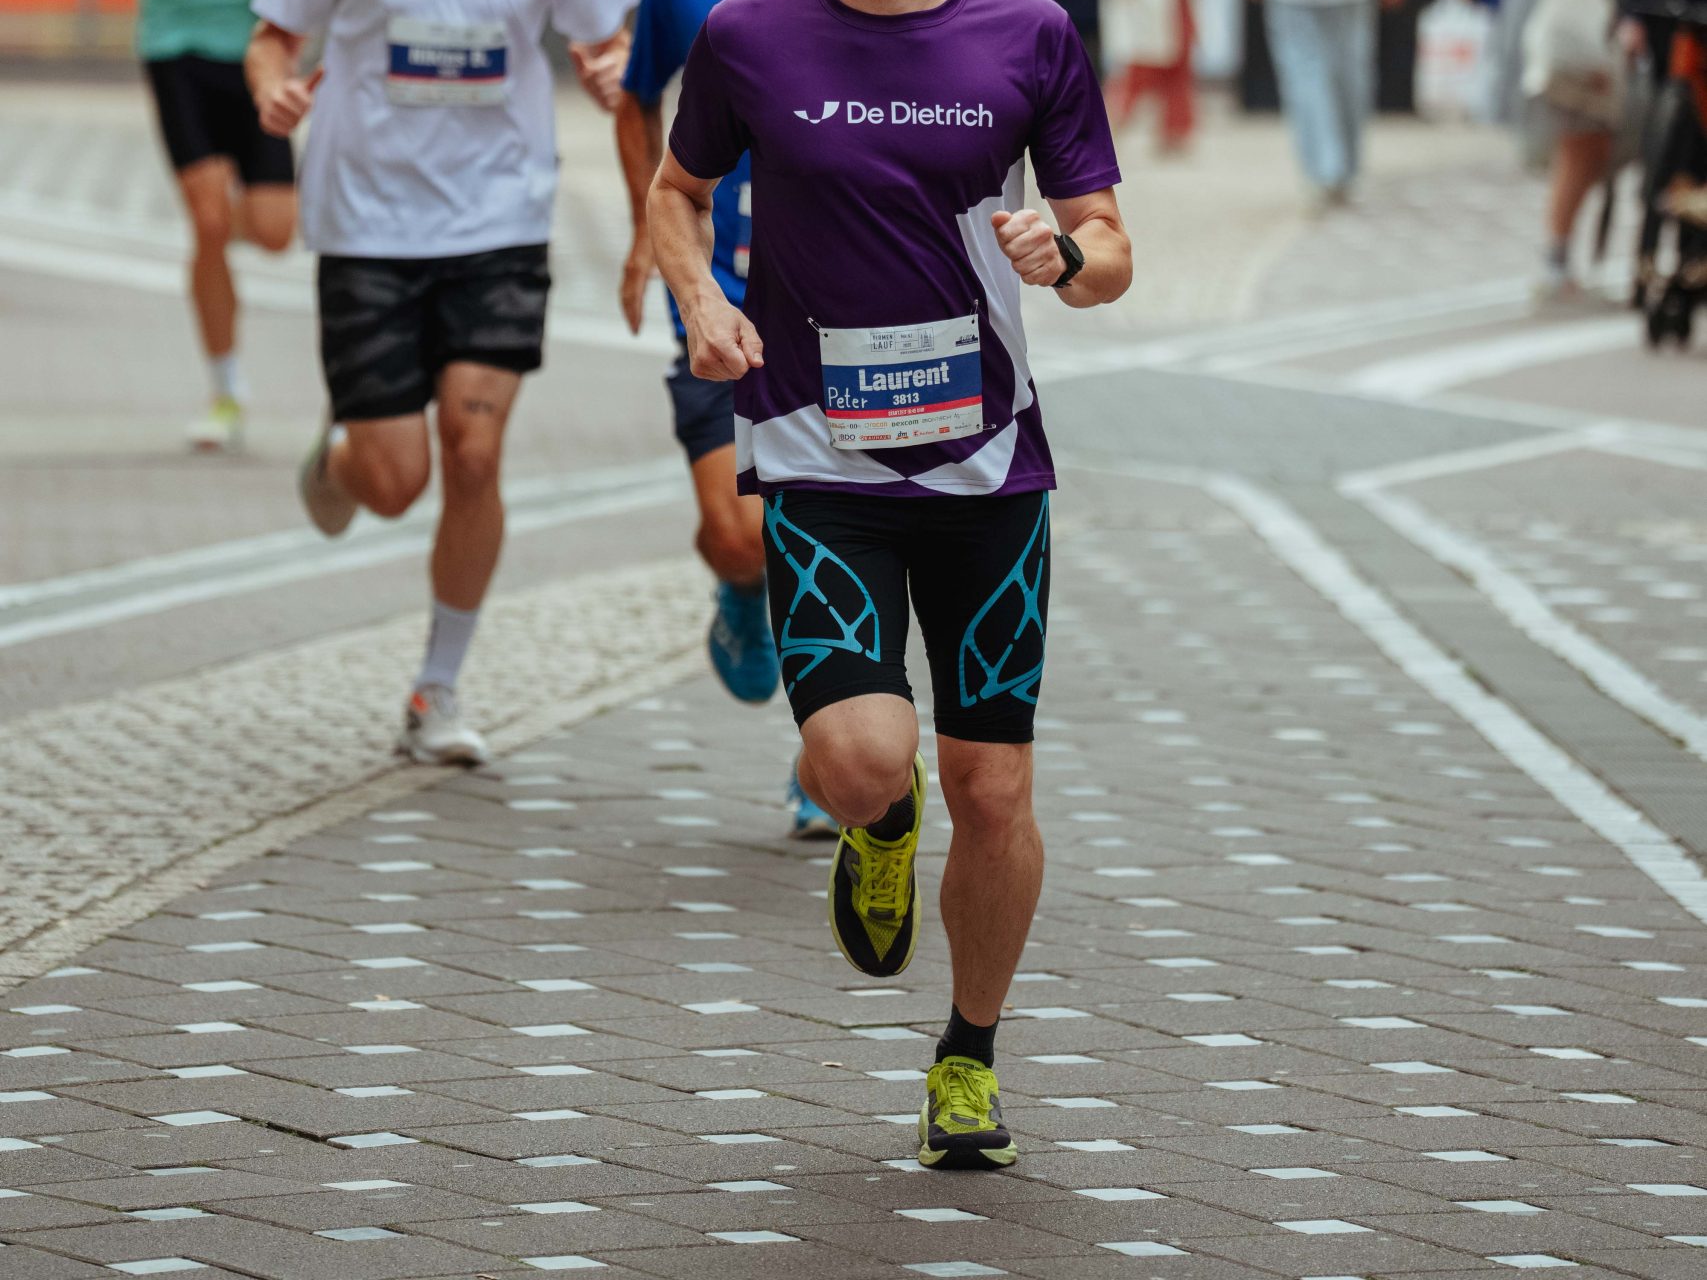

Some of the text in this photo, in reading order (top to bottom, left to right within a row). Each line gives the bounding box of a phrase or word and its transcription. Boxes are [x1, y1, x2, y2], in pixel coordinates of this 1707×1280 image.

[846, 101, 994, 128] De Dietrich
[873, 341, 893, 350] LAUF
[858, 361, 950, 392] Laurent
[828, 387, 869, 409] Peter
[892, 392, 920, 406] 3813
